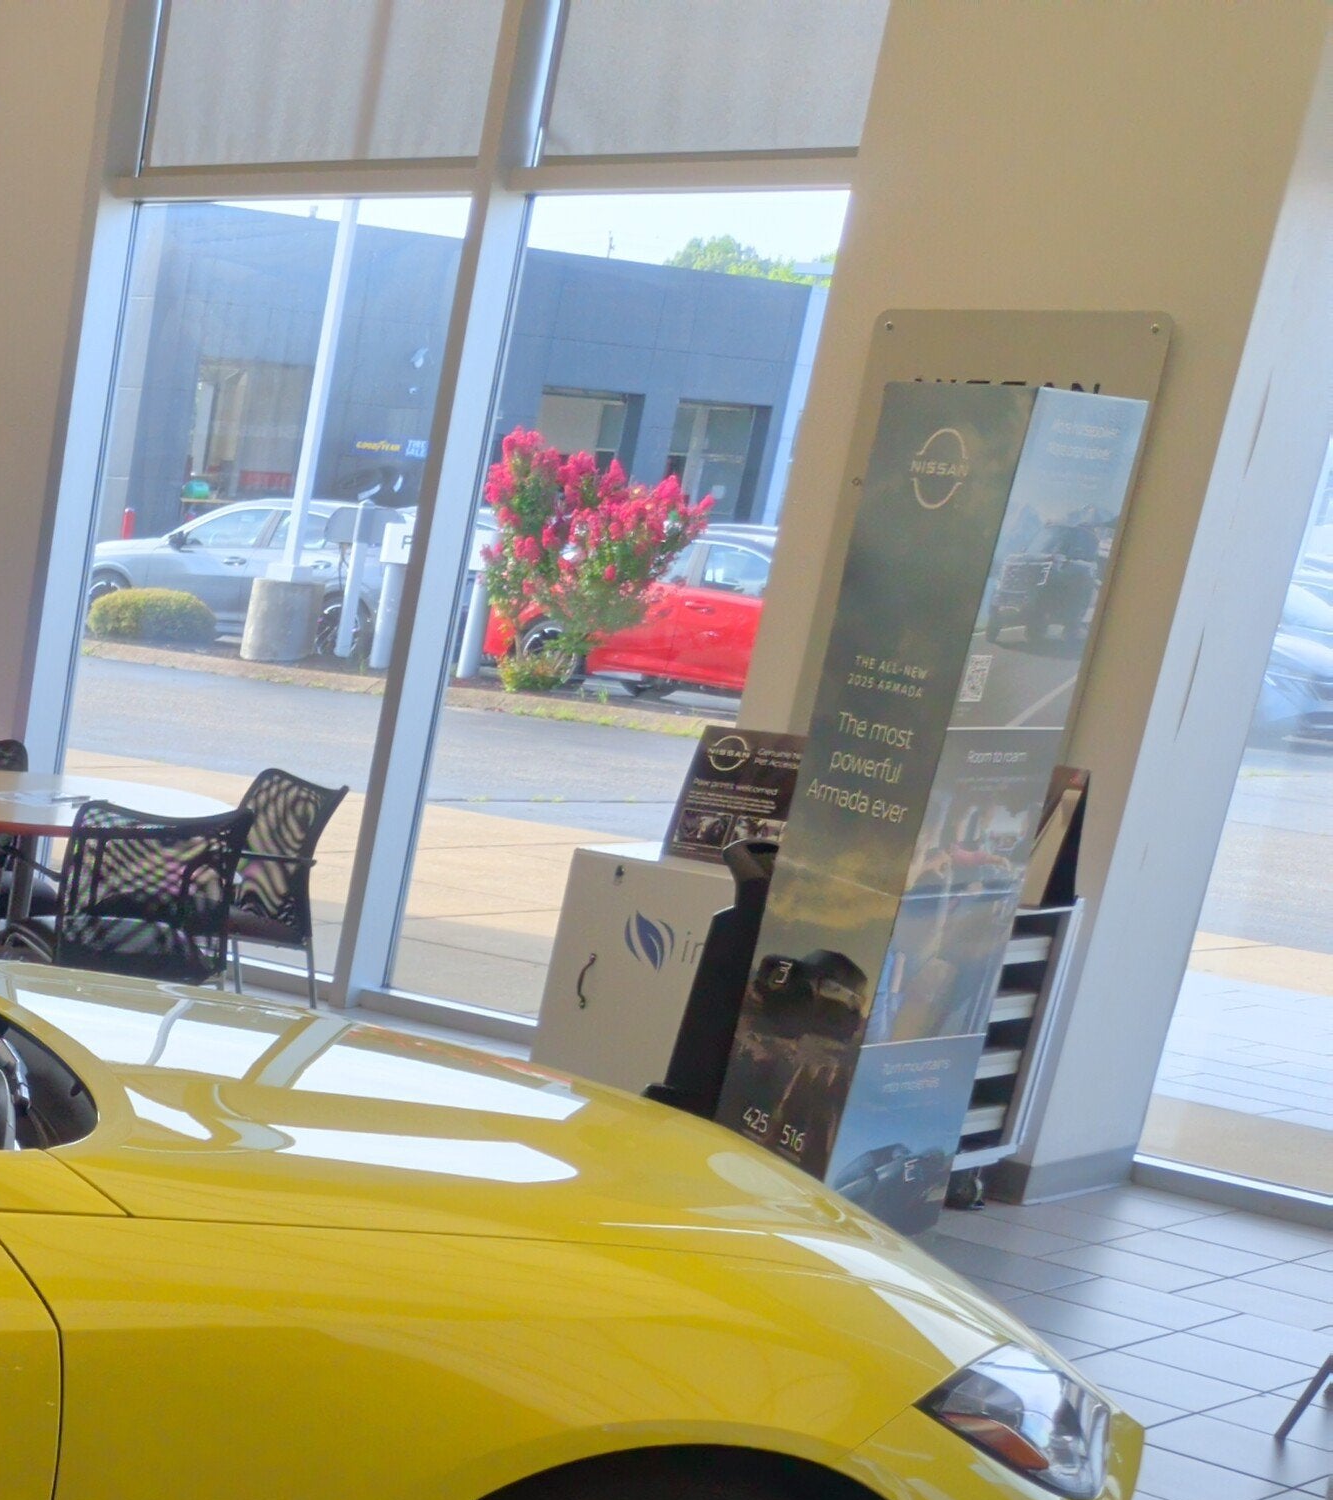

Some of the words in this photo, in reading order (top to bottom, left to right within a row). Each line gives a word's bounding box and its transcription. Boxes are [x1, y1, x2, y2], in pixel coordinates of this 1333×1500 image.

[910, 460, 970, 477] NISSAN
[855, 655, 876, 669] THE
[878, 662, 929, 680] ALL-NEW
[847, 673, 874, 690] 2025
[877, 680, 924, 698] ARMADA
[837, 711, 867, 738] The
[869, 722, 915, 750] most
[707, 748, 751, 759] NISSAN
[967, 750, 991, 764] Room
[992, 751, 1002, 764] to
[829, 751, 904, 785] powerful
[806, 778, 869, 814] Armada
[871, 800, 909, 824] ever
[742, 1106, 768, 1134] 425
[779, 1124, 807, 1152] 516
